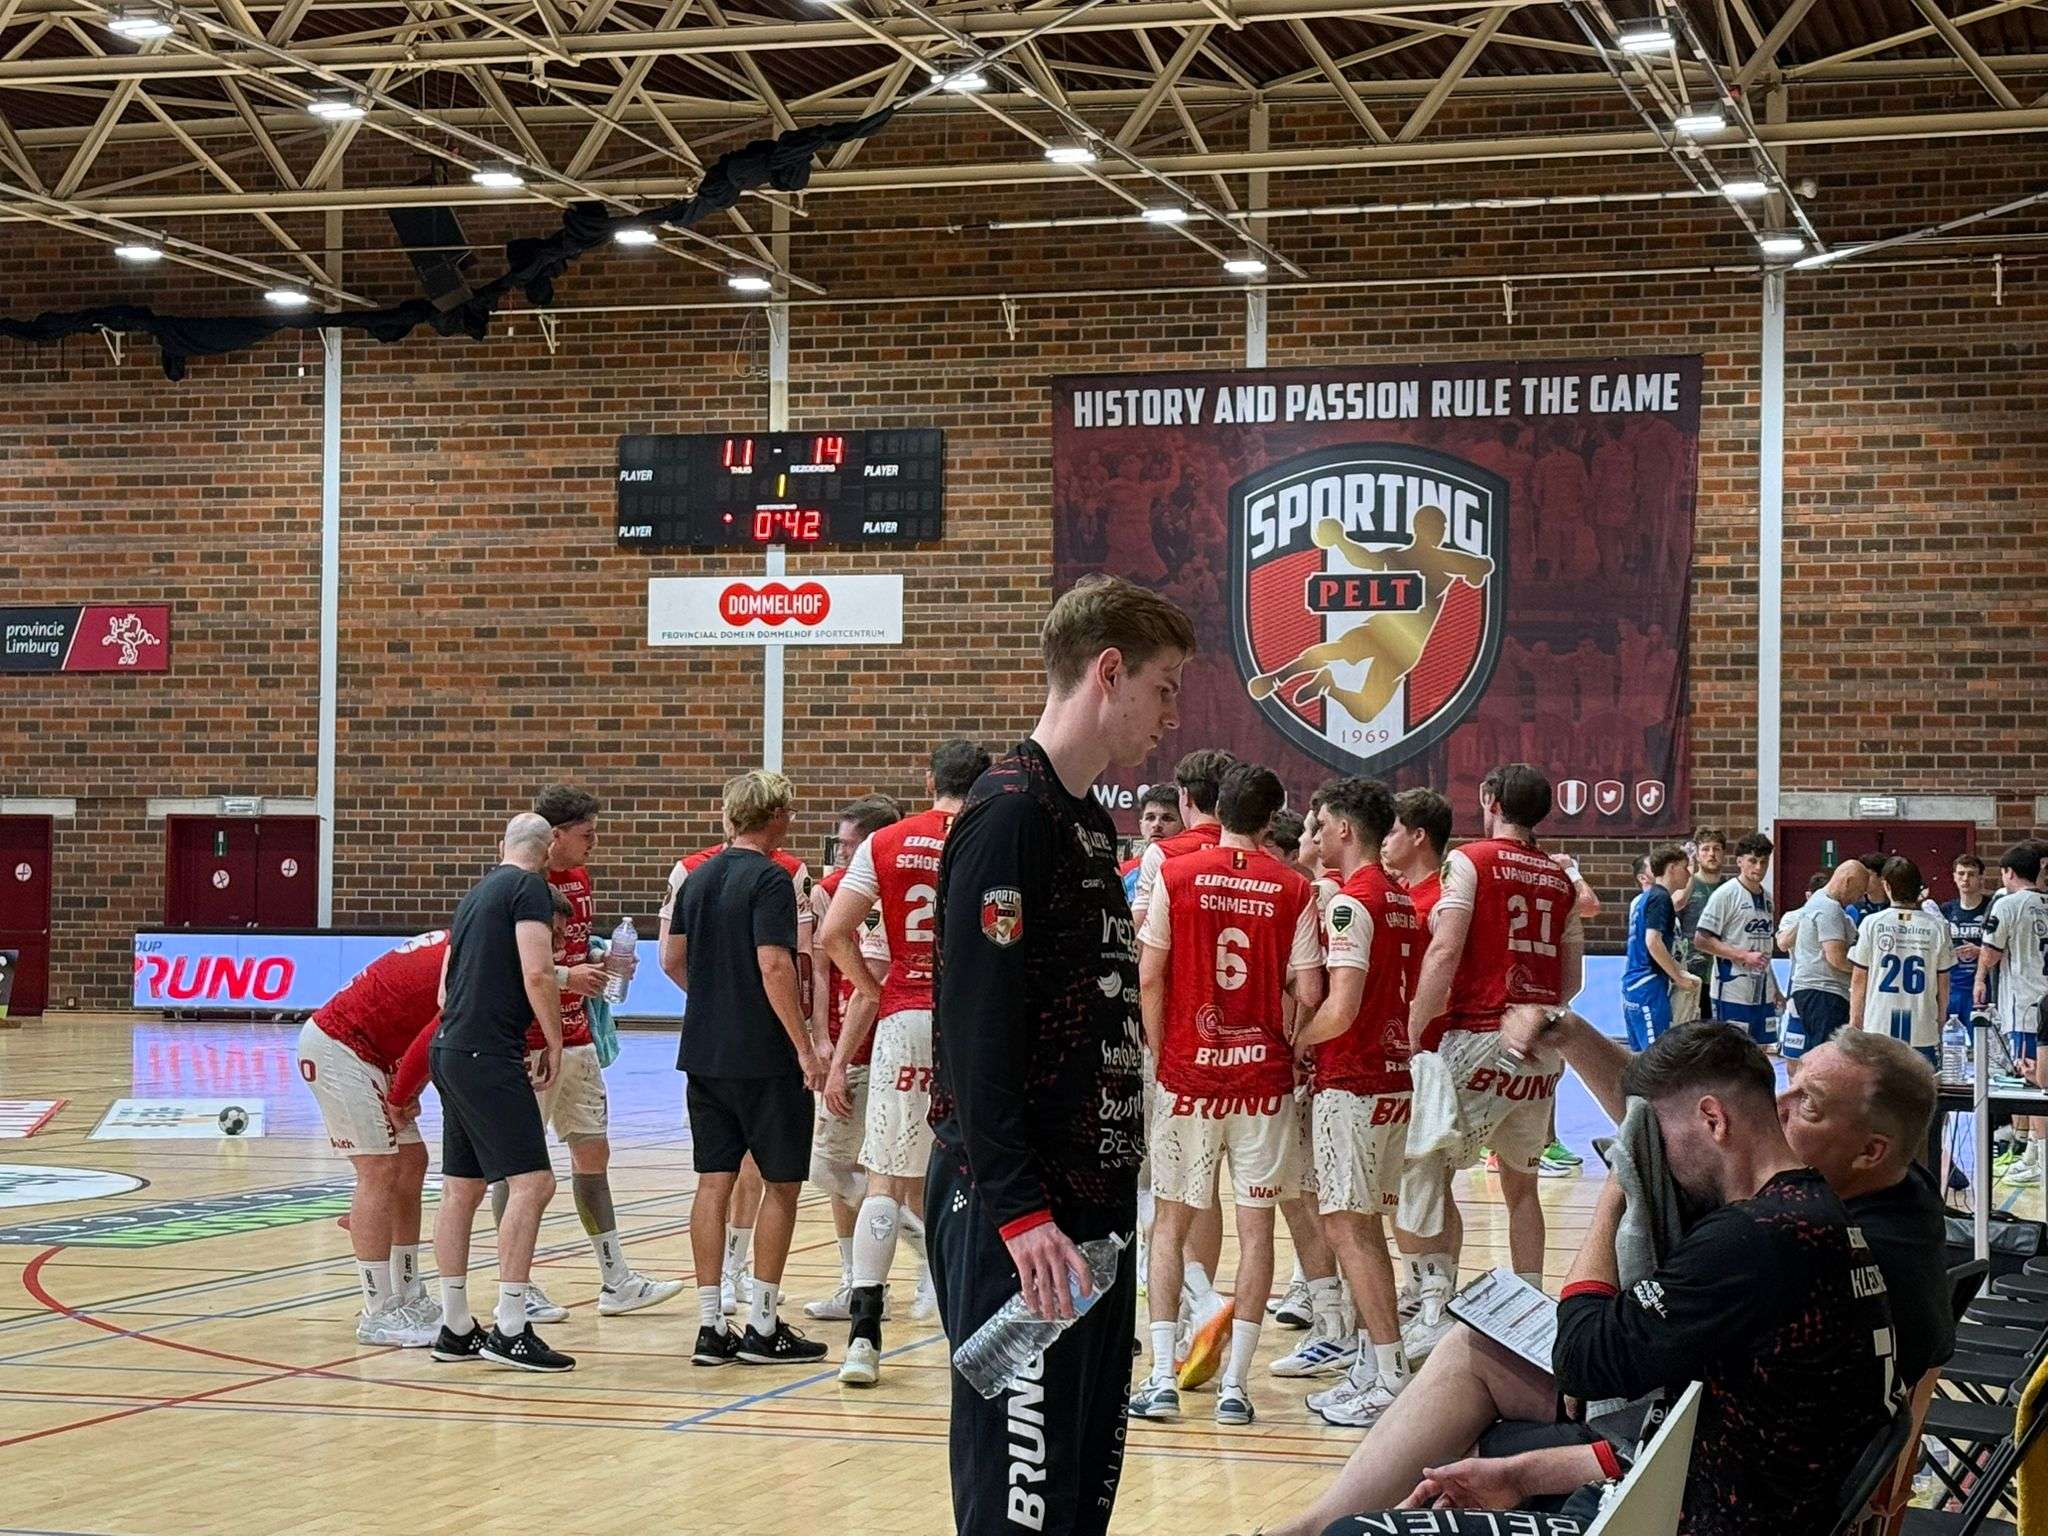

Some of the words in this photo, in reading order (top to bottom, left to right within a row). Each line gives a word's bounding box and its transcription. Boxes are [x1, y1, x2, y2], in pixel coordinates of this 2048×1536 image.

[1073, 387, 1205, 427] HISTORY
[1213, 385, 1277, 424] AND
[1286, 380, 1419, 422] PASSION
[1431, 378, 1511, 418] RULE
[1521, 375, 1580, 415] THE
[1589, 373, 1681, 413] GAME
[815, 436, 843, 464] 14
[619, 469, 654, 482] PLAYER
[863, 464, 899, 477] PLAYER
[862, 521, 898, 534] PLAYER
[1251, 473, 1485, 560] SPORTING
[618, 525, 653, 538] PLAYER
[729, 593, 824, 615] DOMMELHOF
[1318, 578, 1413, 608] PELT
[6, 621, 65, 639] provincie
[661, 631, 719, 640] PROVINCIAAL
[720, 631, 755, 639] DOMEIN
[757, 630, 813, 639] DOMMELHOF
[815, 629, 885, 639] SPORTCENTRUM
[5, 639, 60, 657] Limburg
[1340, 729, 1391, 744] 1969
[1092, 784, 1134, 809] We
[1194, 873, 1284, 894] EUROQUIP
[1199, 893, 1275, 918] SCHMEITS
[1215, 926, 1251, 991] 6
[134, 955, 295, 1002] RUNO
[1879, 954, 1926, 995] 26
[1194, 1043, 1268, 1068] BRUNO
